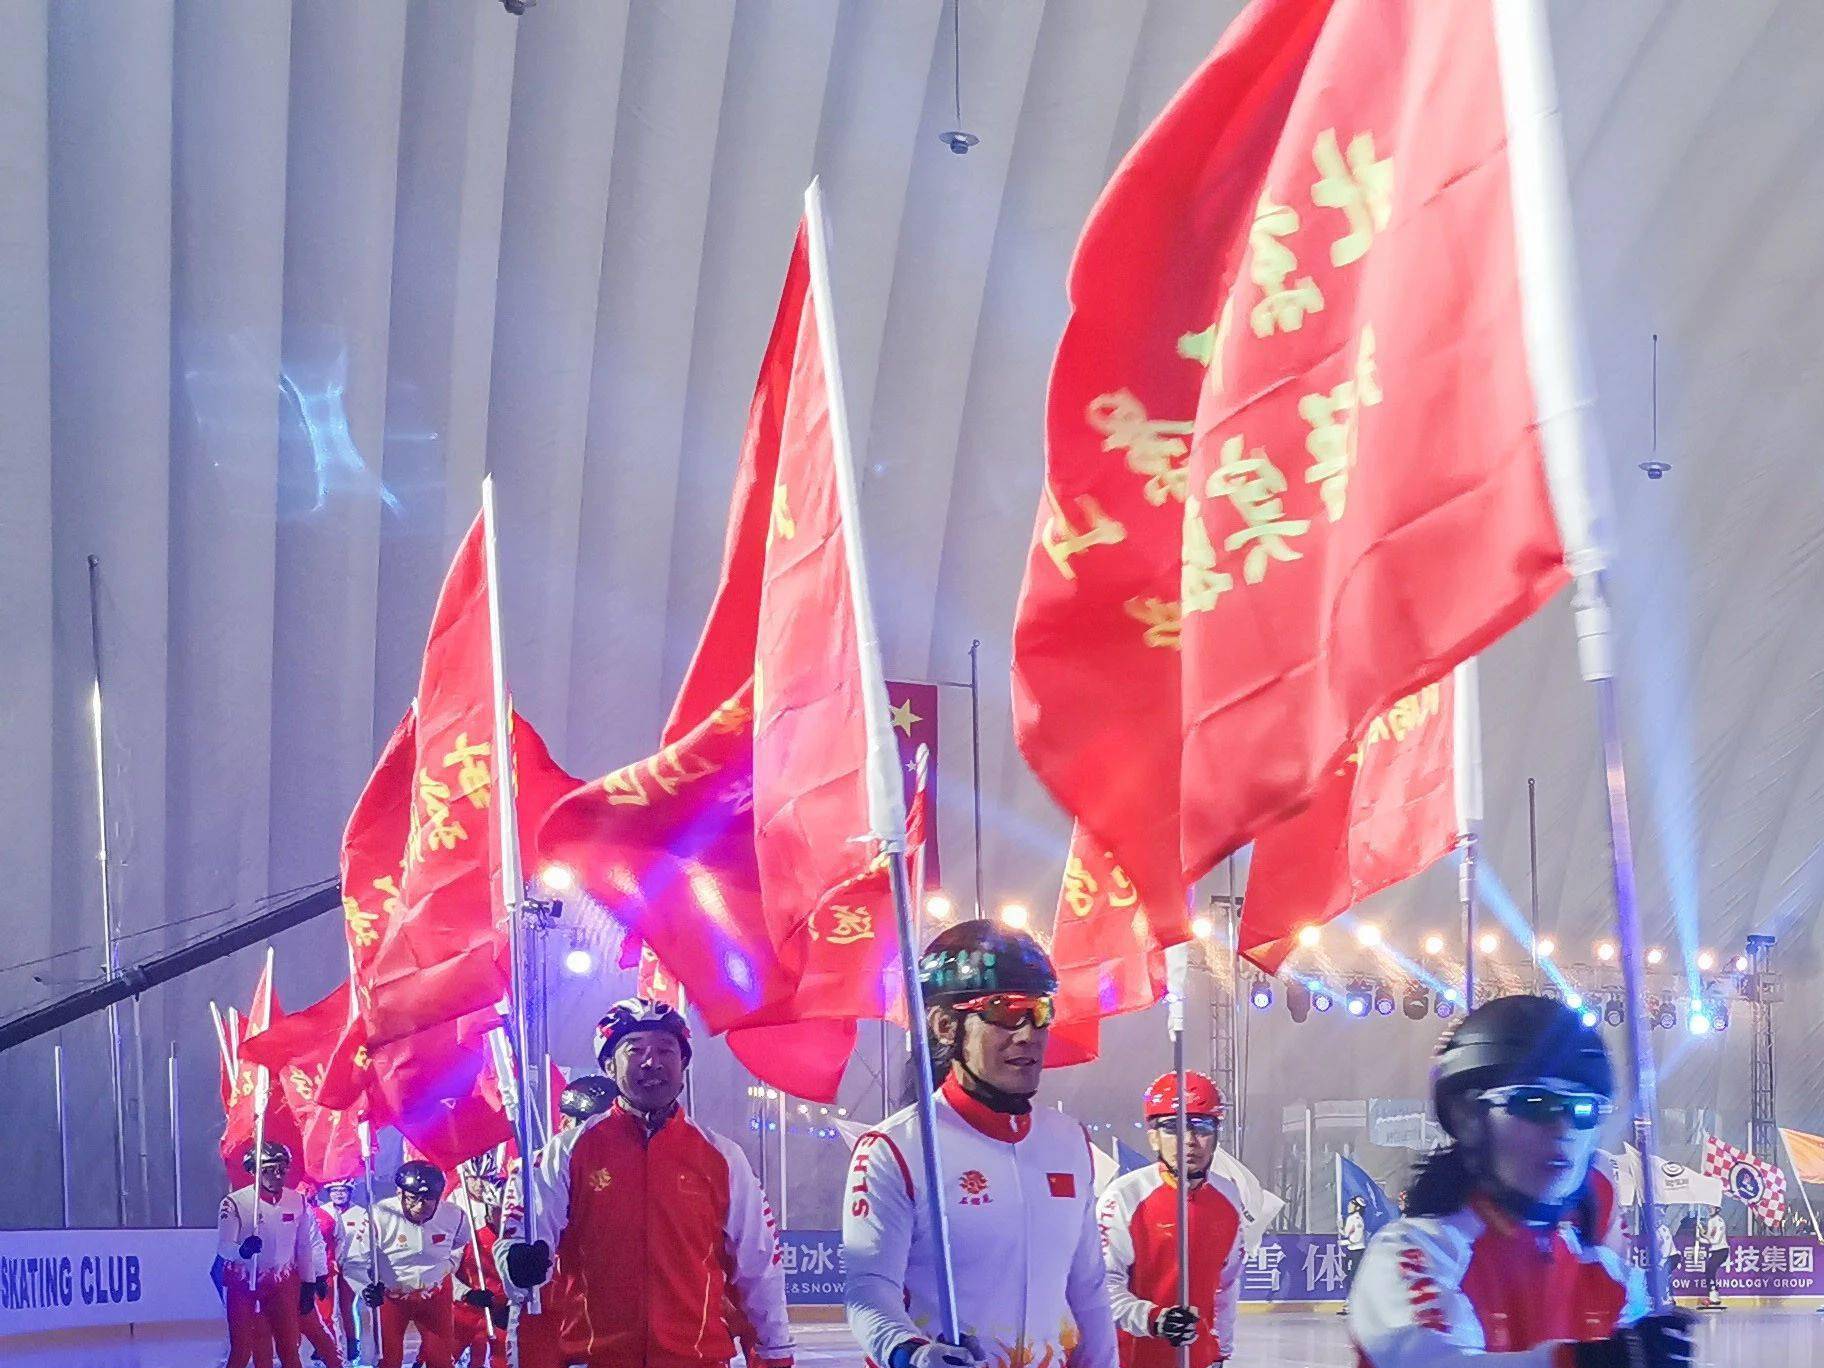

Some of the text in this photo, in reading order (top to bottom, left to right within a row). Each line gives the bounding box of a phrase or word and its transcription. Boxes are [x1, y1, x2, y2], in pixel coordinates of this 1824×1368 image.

[1, 1255, 142, 1309] SKATING CLUB
[1773, 1279, 1814, 1288] GROUP
